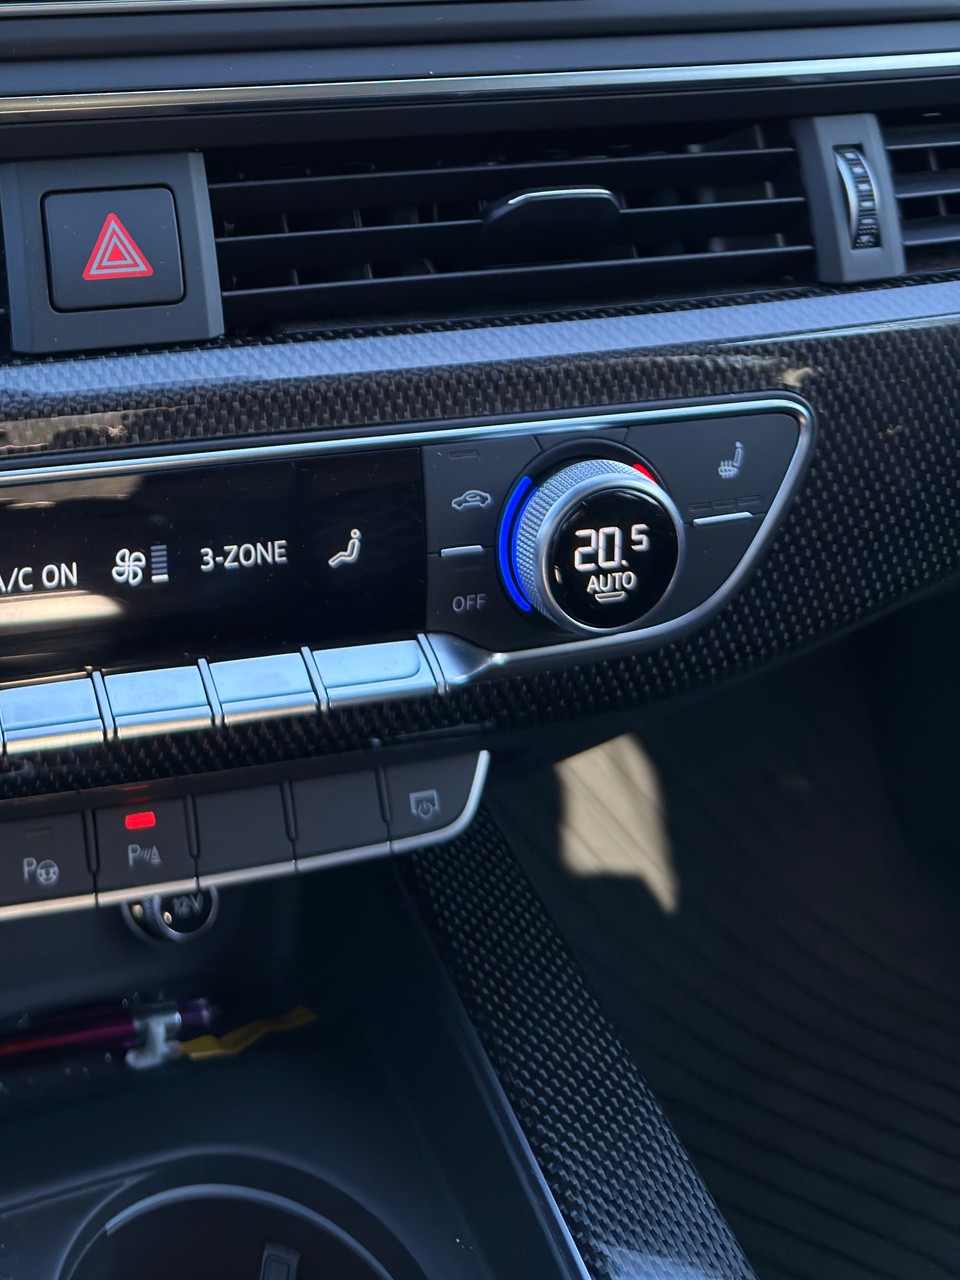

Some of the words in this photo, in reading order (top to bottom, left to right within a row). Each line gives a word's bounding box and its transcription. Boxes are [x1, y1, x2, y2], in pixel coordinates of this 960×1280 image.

[200, 540, 288, 572] 3-ZONE
[41, 562, 79, 589] ON
[587, 570, 637, 593] AUTO
[452, 594, 487, 613] OFF
